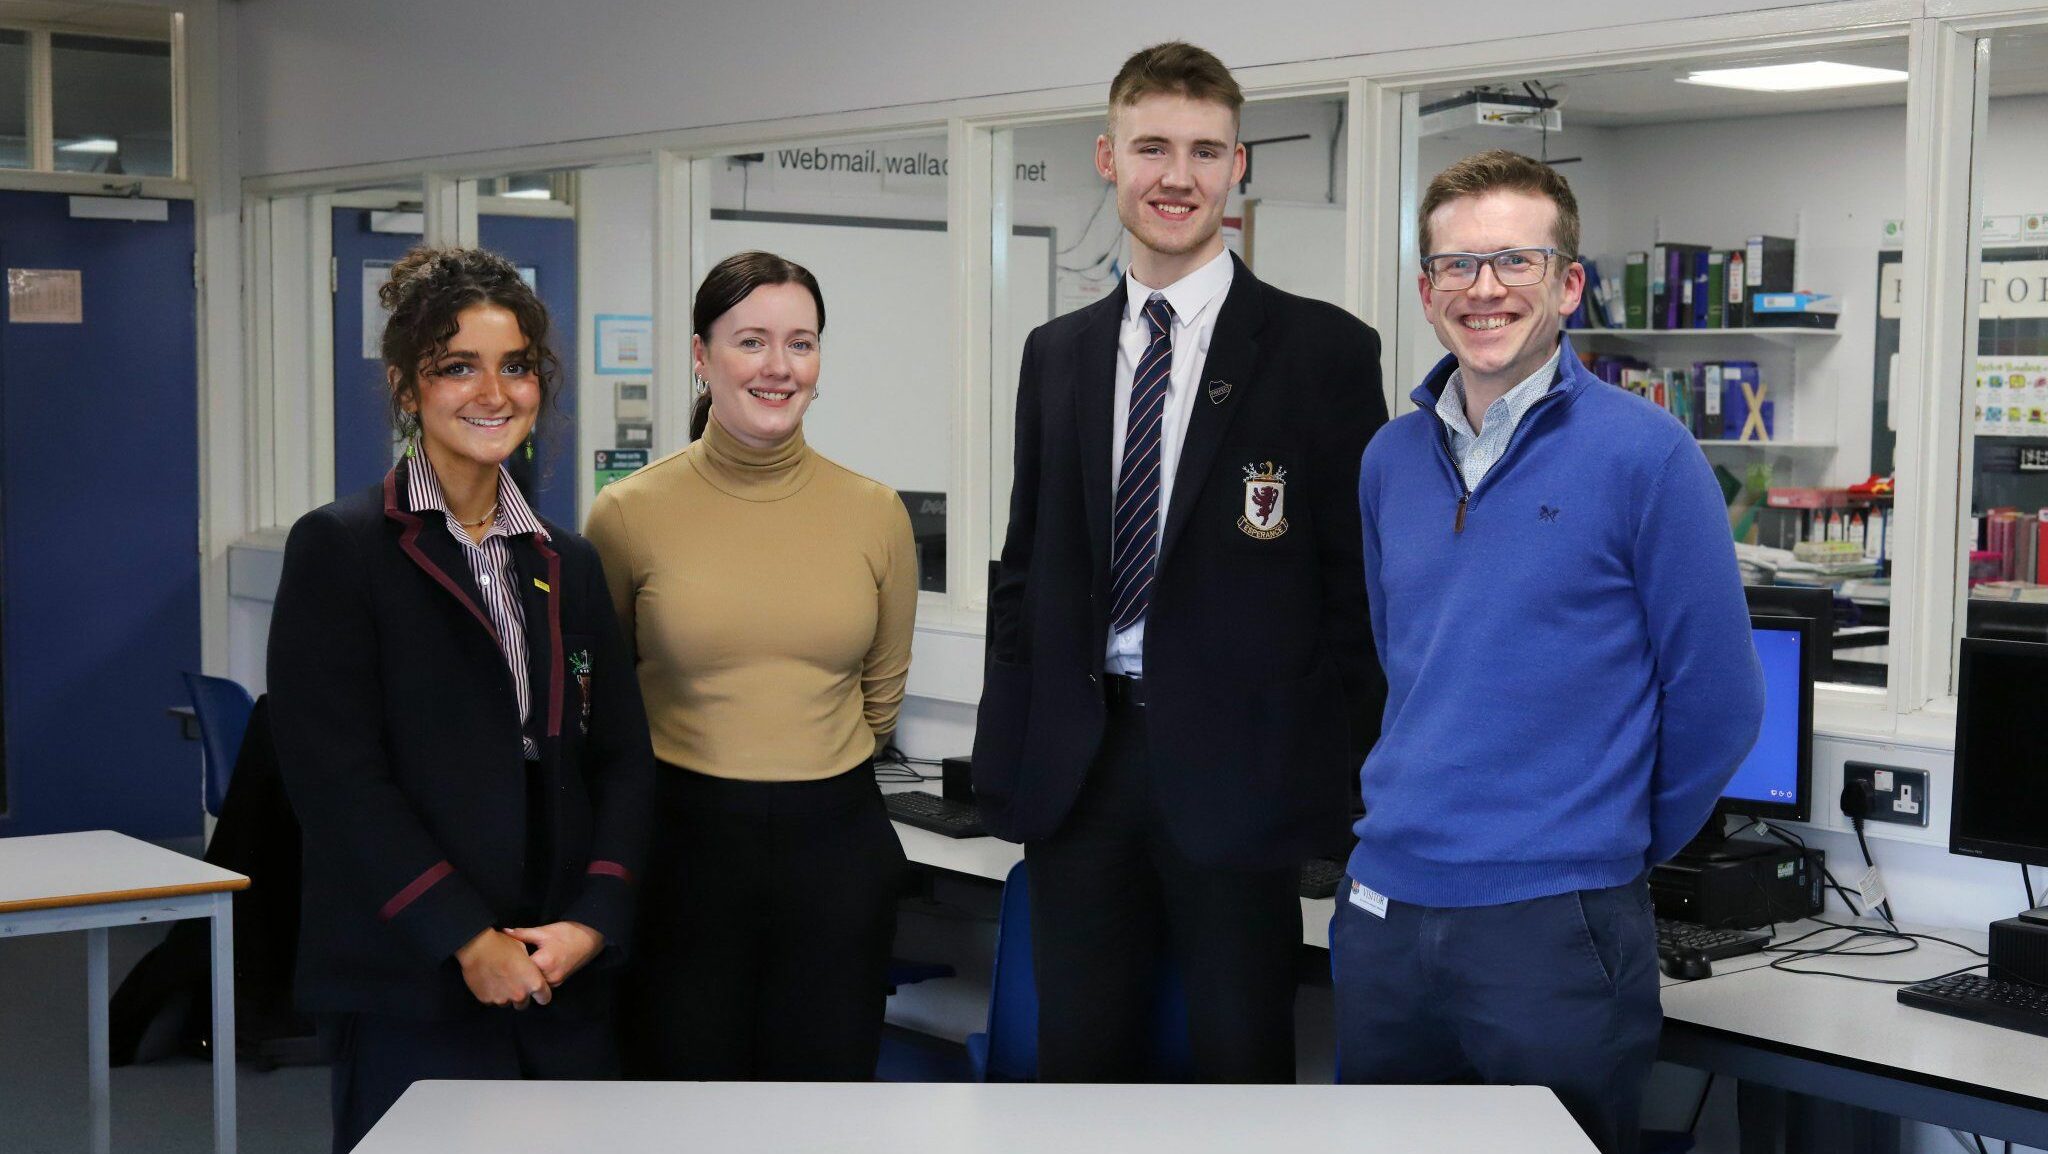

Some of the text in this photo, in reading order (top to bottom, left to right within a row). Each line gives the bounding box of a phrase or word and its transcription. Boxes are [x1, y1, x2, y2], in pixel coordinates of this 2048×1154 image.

[777, 147, 881, 174] Webmail.
[1244, 524, 1283, 538] ESPERANCE
[1362, 888, 1385, 905] VISITOR
